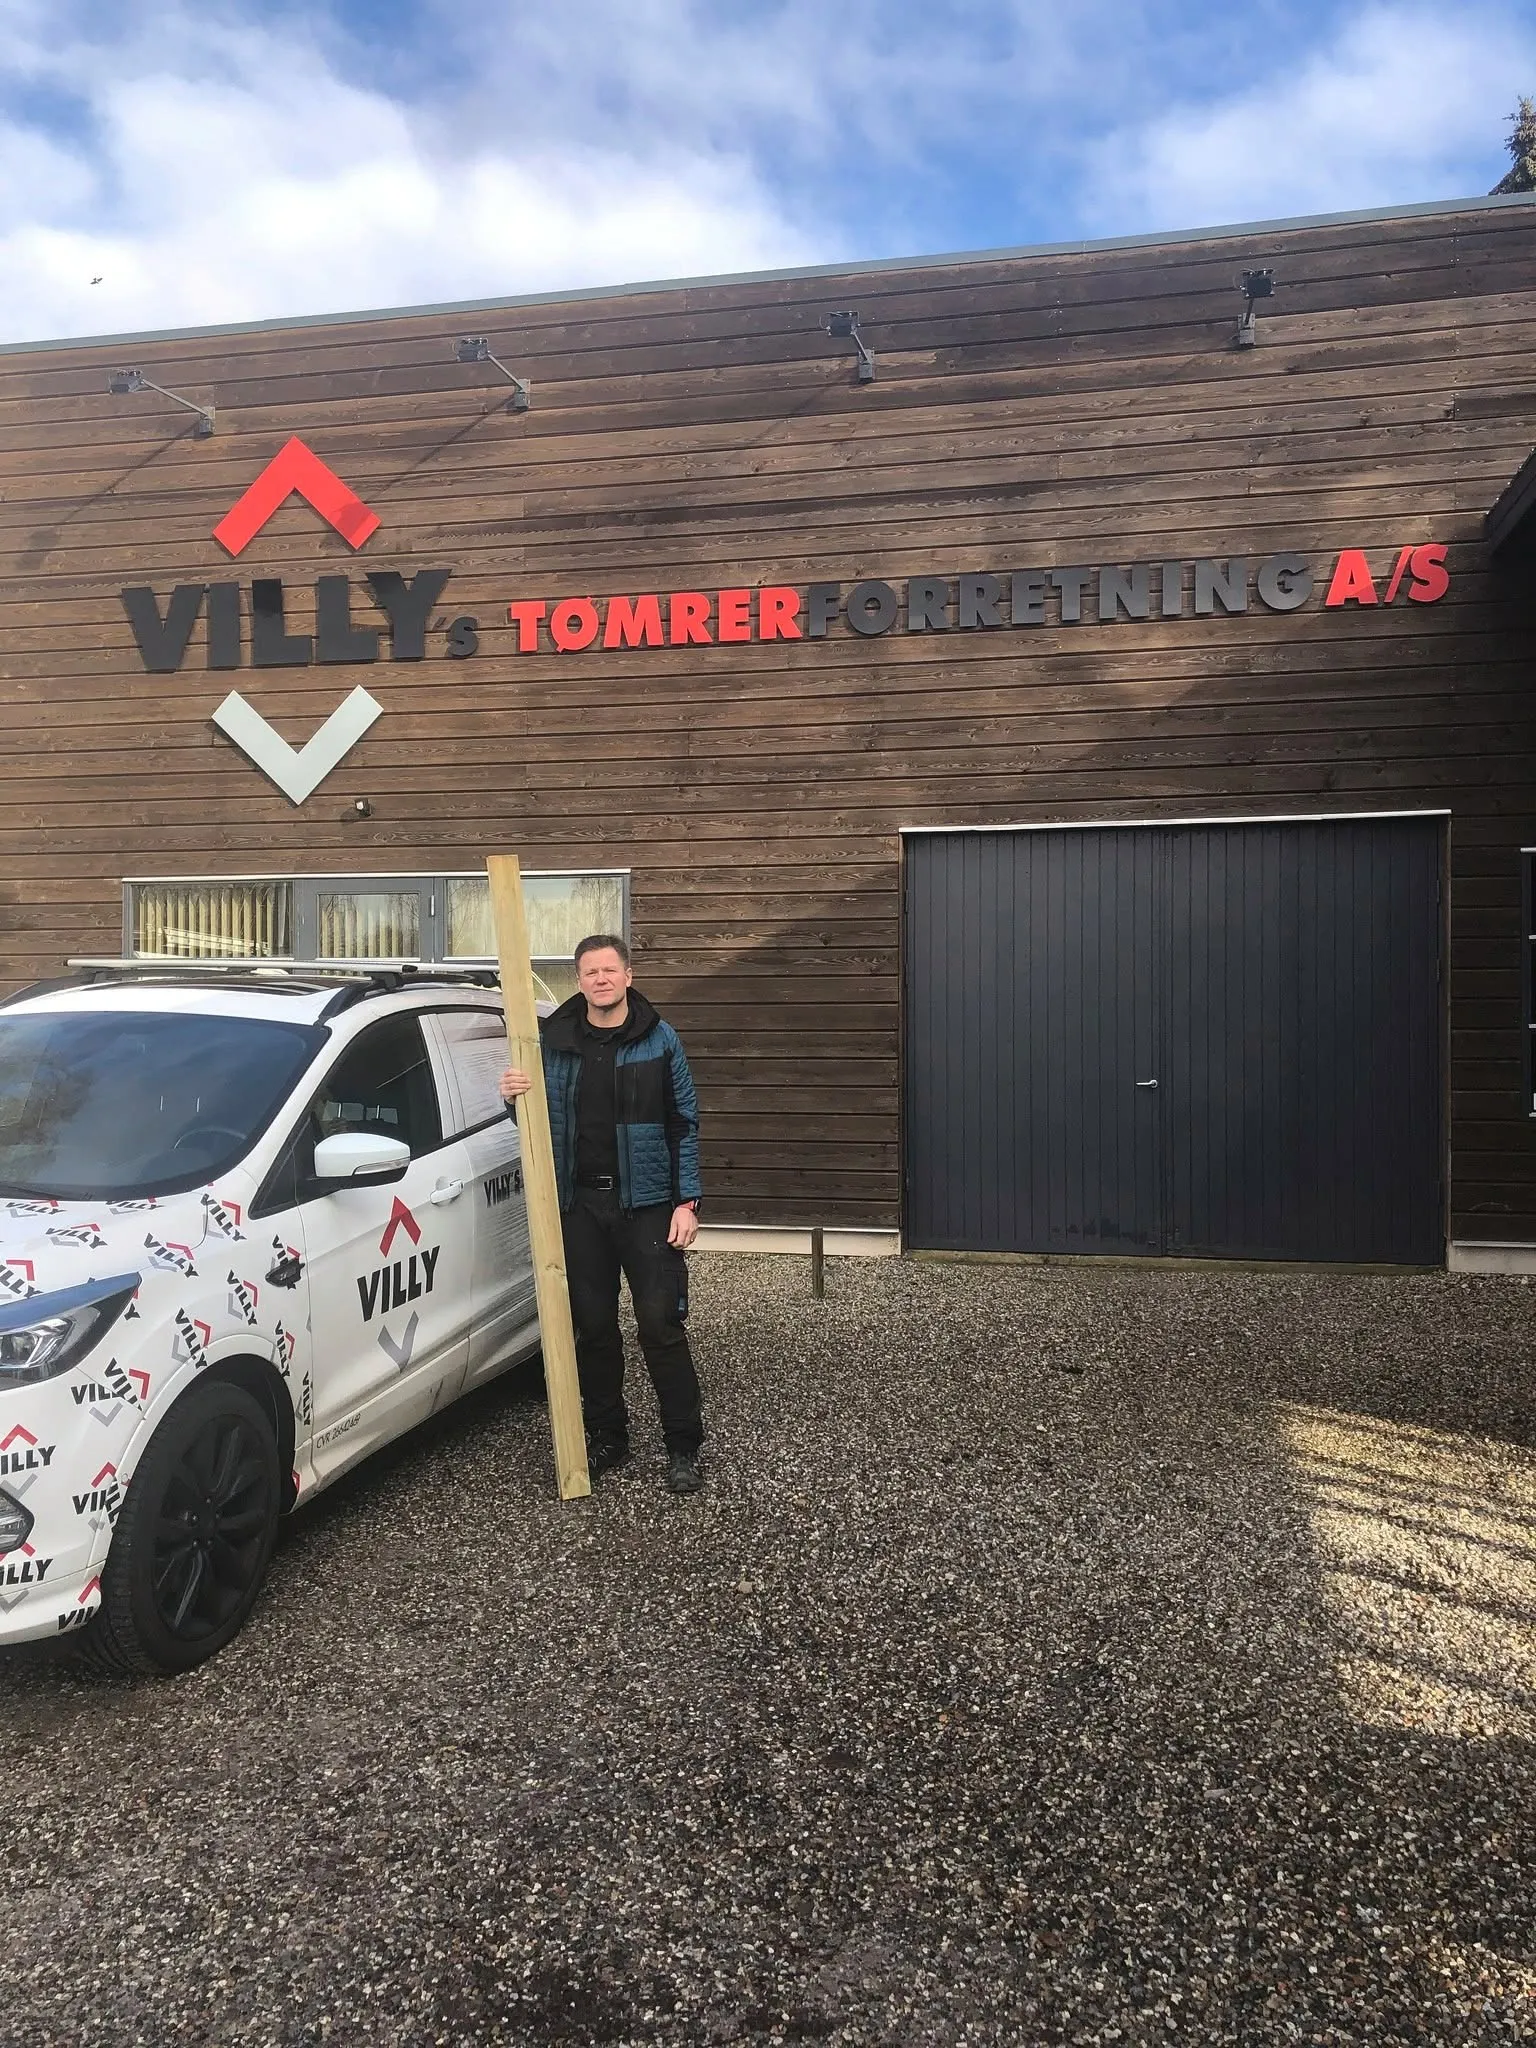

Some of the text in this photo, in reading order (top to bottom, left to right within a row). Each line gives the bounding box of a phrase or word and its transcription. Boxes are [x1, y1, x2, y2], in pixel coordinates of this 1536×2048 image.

[1325, 543, 1449, 607] A/S
[5, 1202, 67, 1215] VILLY
[200, 1193, 247, 1242] VILLY
[45, 1227, 108, 1249] VILLY
[144, 1232, 199, 1278] VILLY
[227, 1269, 257, 1326] VILLY
[357, 1245, 441, 1322] VILLY
[175, 1308, 207, 1369] VILLY
[0, 1445, 56, 1476] ILLY
